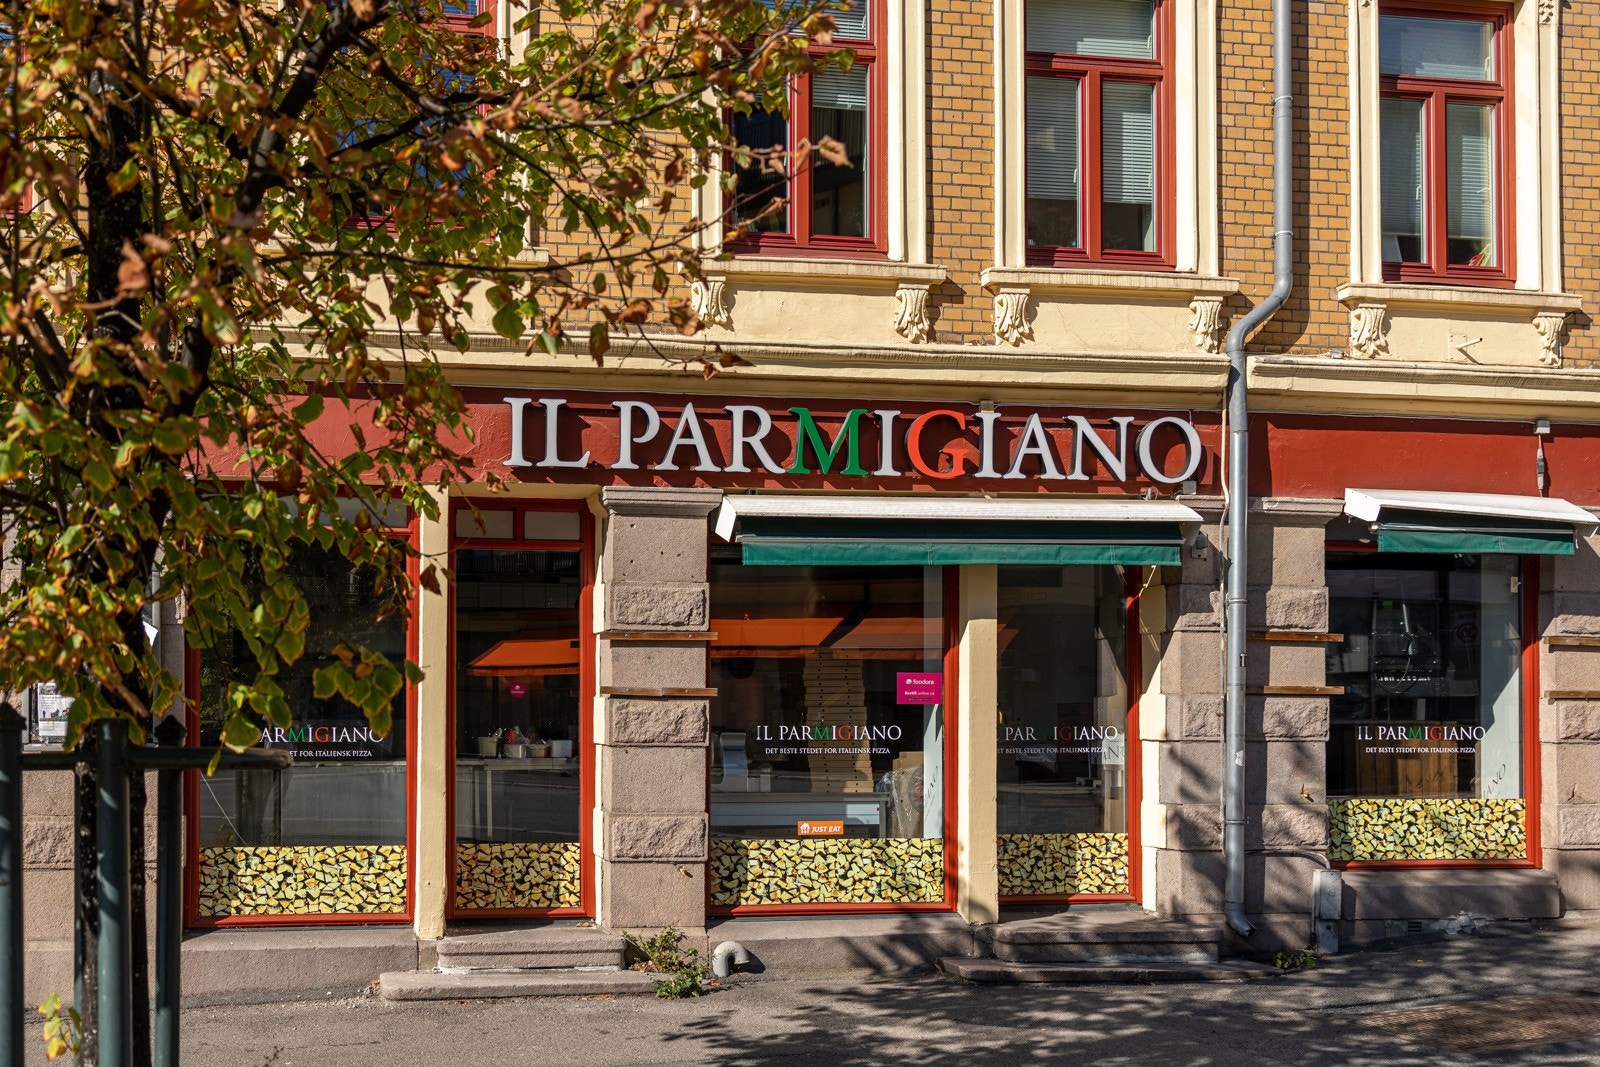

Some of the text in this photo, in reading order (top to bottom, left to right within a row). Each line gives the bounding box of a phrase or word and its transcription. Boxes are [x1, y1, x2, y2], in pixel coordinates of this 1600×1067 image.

[502, 396, 1204, 485] IL PARMIGIANO
[755, 725, 902, 741] IL PARMIGIANO
[1357, 725, 1486, 741] IL PARMIGIANO
[811, 825, 828, 833] JUST
